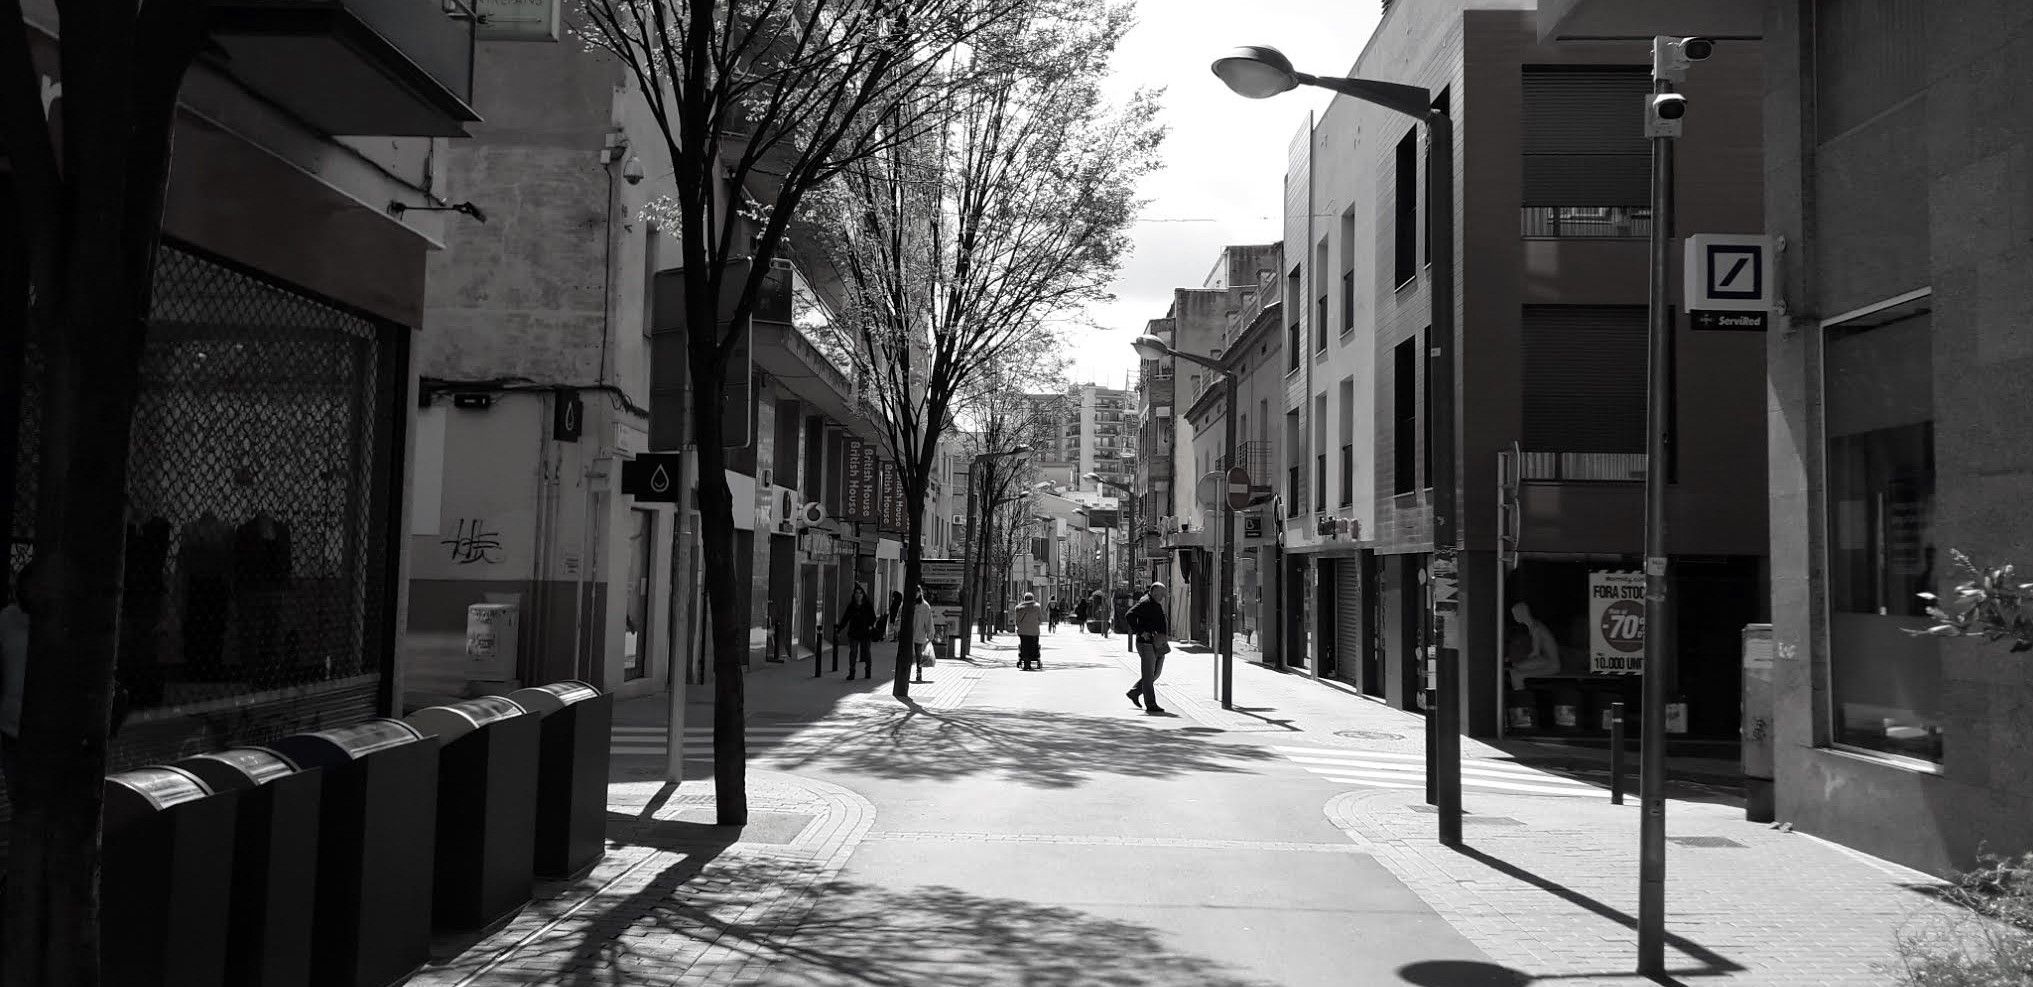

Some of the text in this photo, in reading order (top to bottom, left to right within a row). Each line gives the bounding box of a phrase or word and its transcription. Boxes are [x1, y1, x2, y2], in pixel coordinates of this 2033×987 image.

[1718, 315, 1761, 326] ServiRed
[848, 441, 861, 515] British House
[862, 448, 874, 517] British House
[883, 463, 893, 525] British House
[895, 500, 904, 527] House
[1593, 585, 1646, 599] FORA STOC
[1595, 657, 1643, 669] 10.000 UNI
